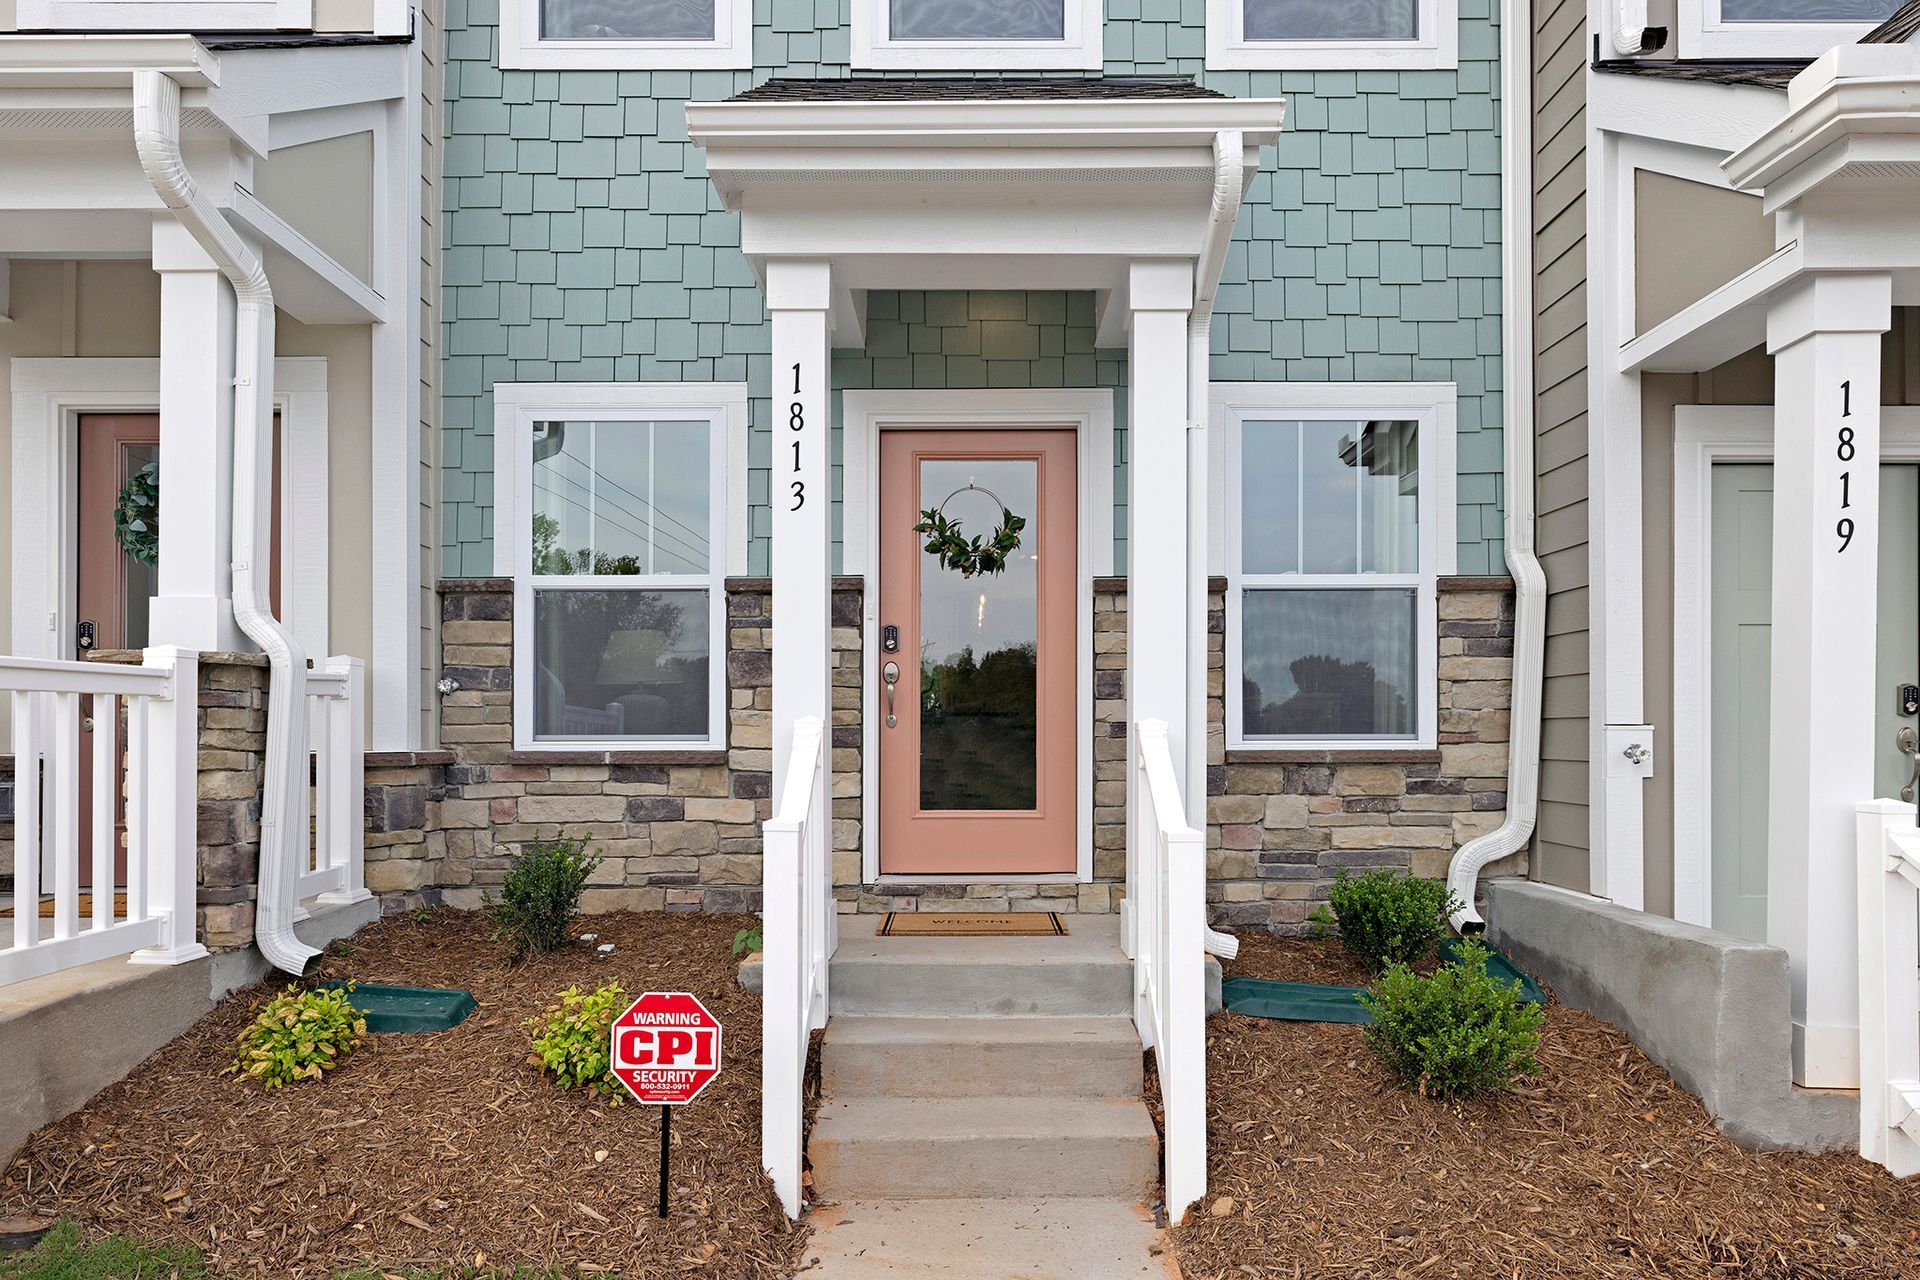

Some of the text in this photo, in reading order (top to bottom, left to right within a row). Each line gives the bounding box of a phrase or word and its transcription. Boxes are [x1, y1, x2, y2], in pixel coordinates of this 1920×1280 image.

[789, 362, 805, 512] 1813
[1837, 380, 1855, 553] 1819
[633, 1012, 701, 1025] WARNING
[620, 1030, 713, 1065] CPI
[633, 1070, 697, 1083] SECURITY
